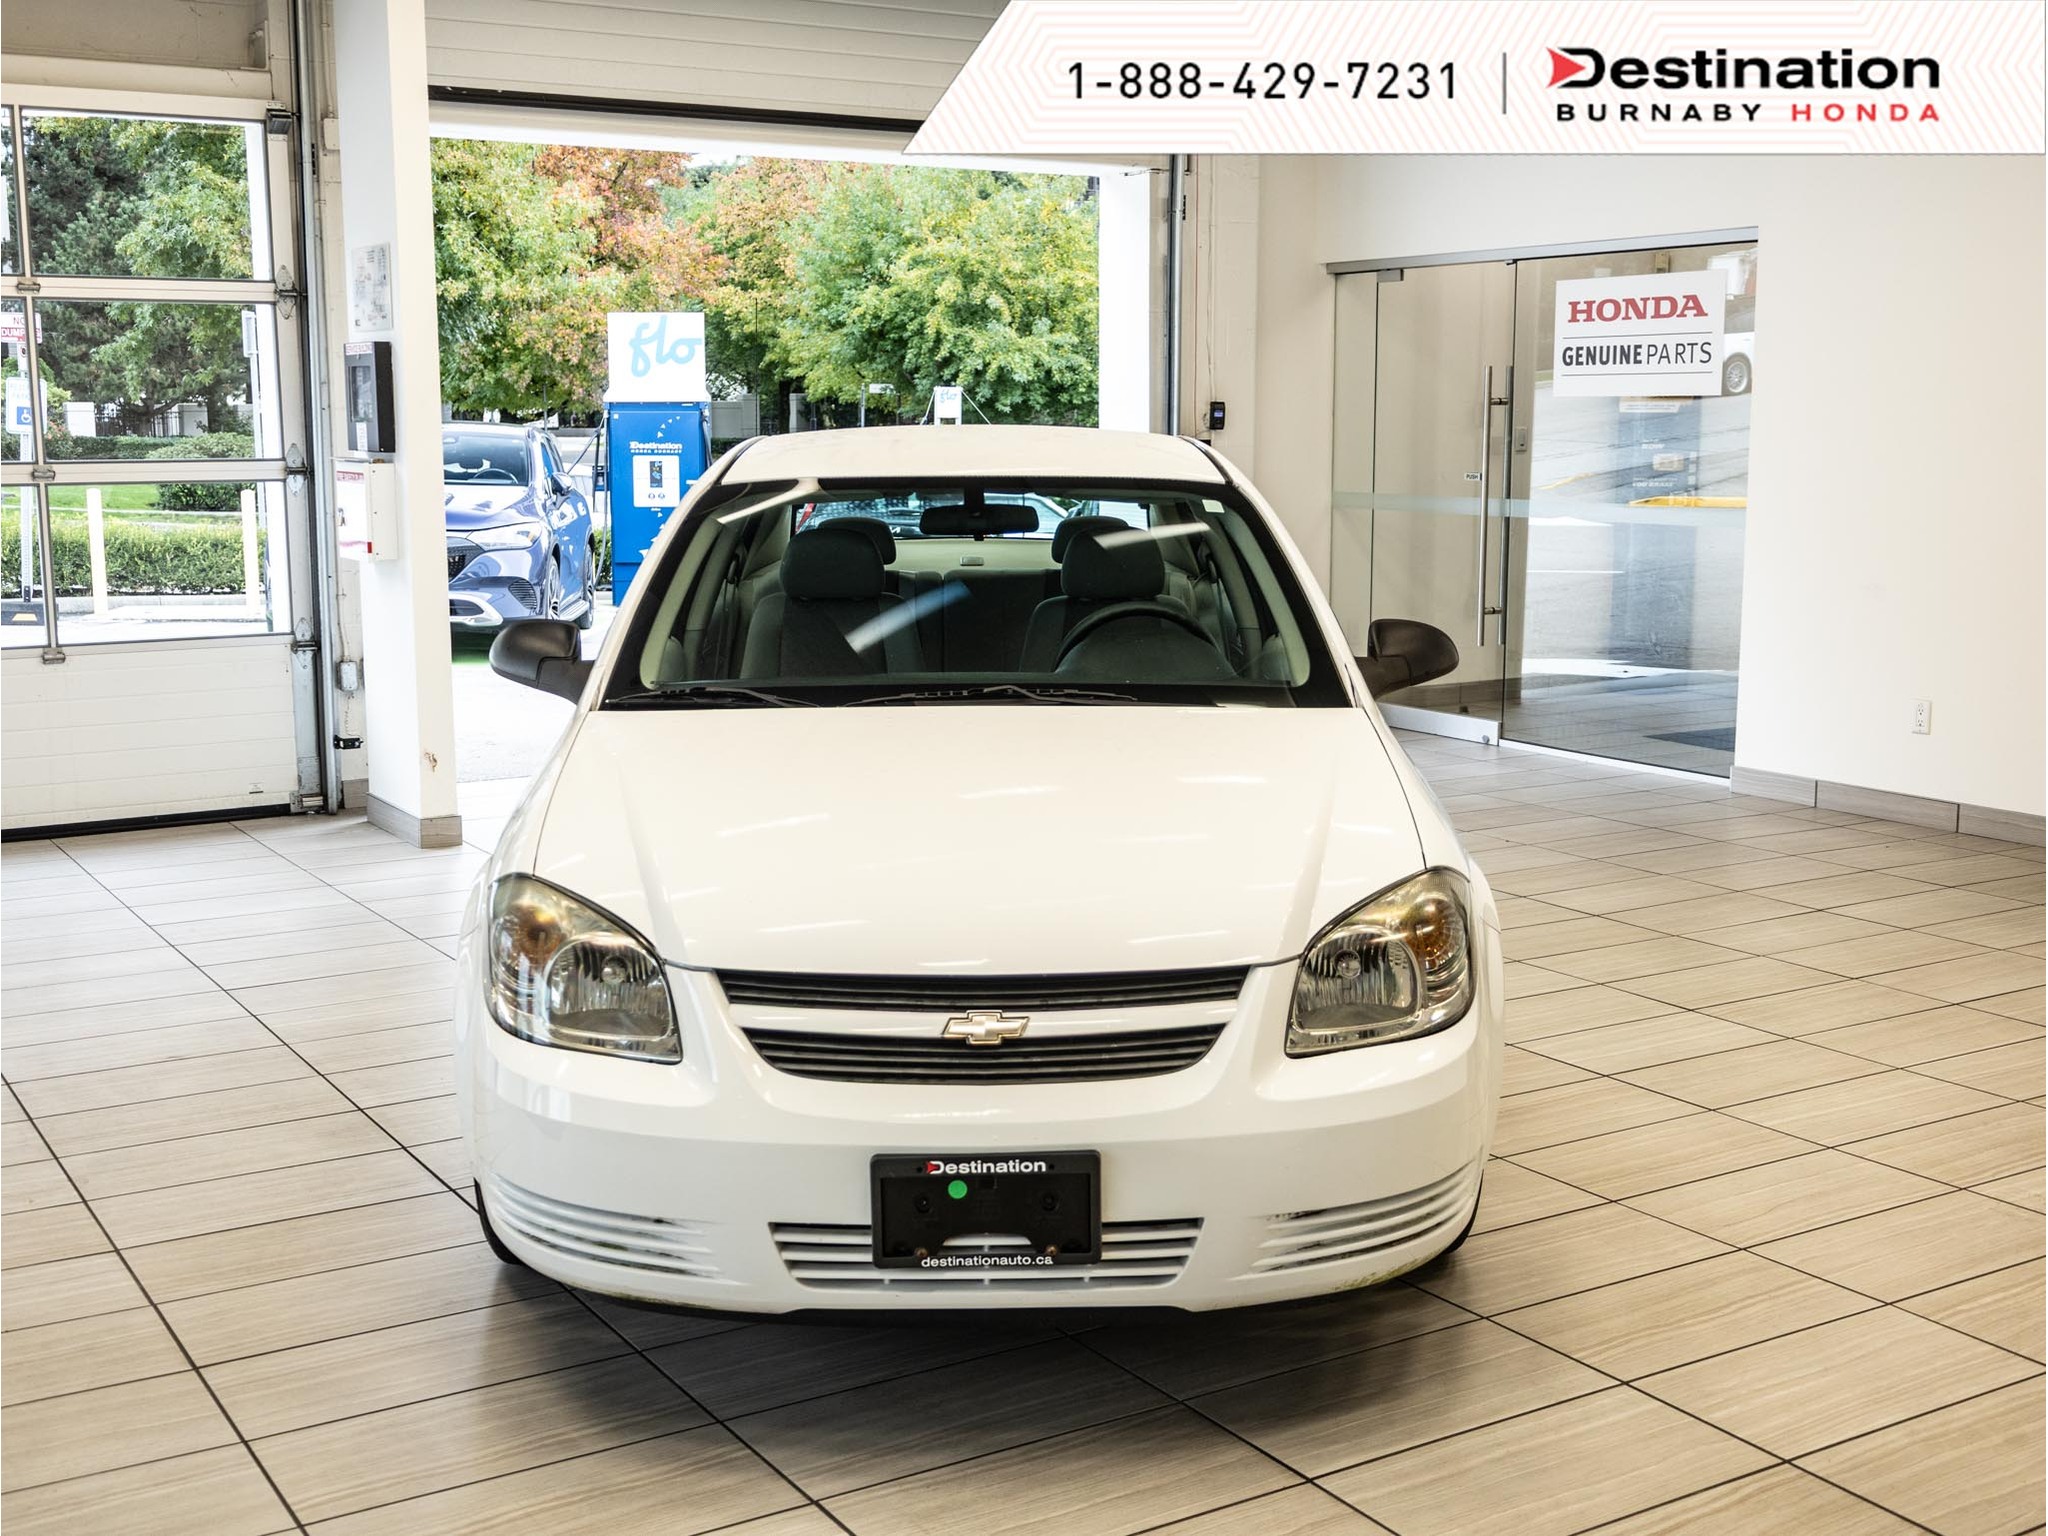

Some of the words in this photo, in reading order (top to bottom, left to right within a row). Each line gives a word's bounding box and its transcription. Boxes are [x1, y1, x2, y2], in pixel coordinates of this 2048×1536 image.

[1568, 294, 1708, 323] HONDA
[628, 314, 703, 378] flo
[927, 1159, 1047, 1175] Destination
[921, 1255, 1054, 1267] destinationauto.ca
